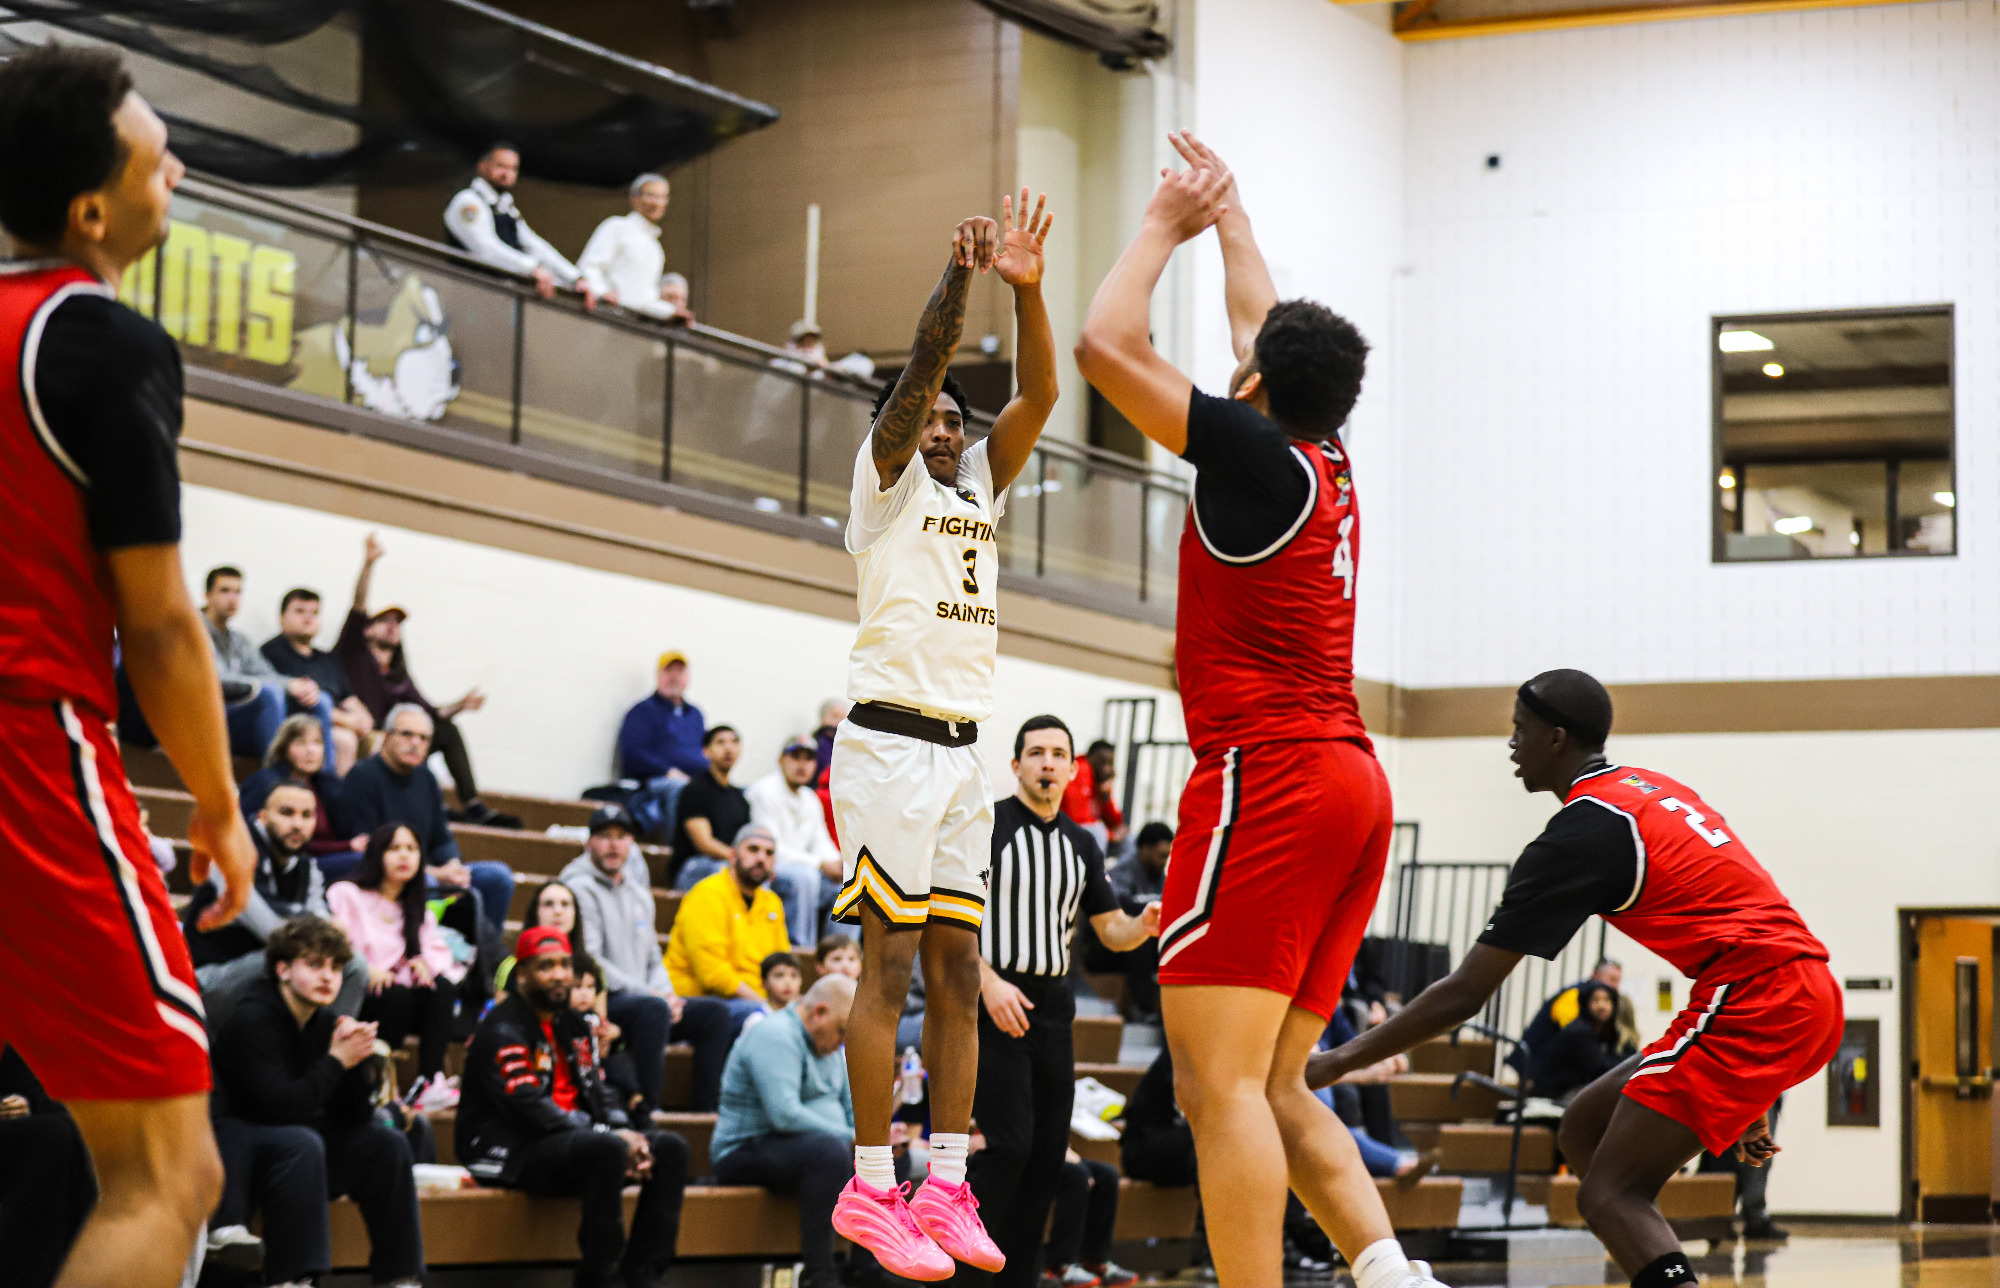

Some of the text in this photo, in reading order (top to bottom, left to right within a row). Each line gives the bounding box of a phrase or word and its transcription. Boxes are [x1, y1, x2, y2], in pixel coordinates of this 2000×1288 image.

[962, 547, 980, 596] 3
[1332, 514, 1355, 600] 4
[1658, 796, 1732, 849] 2
